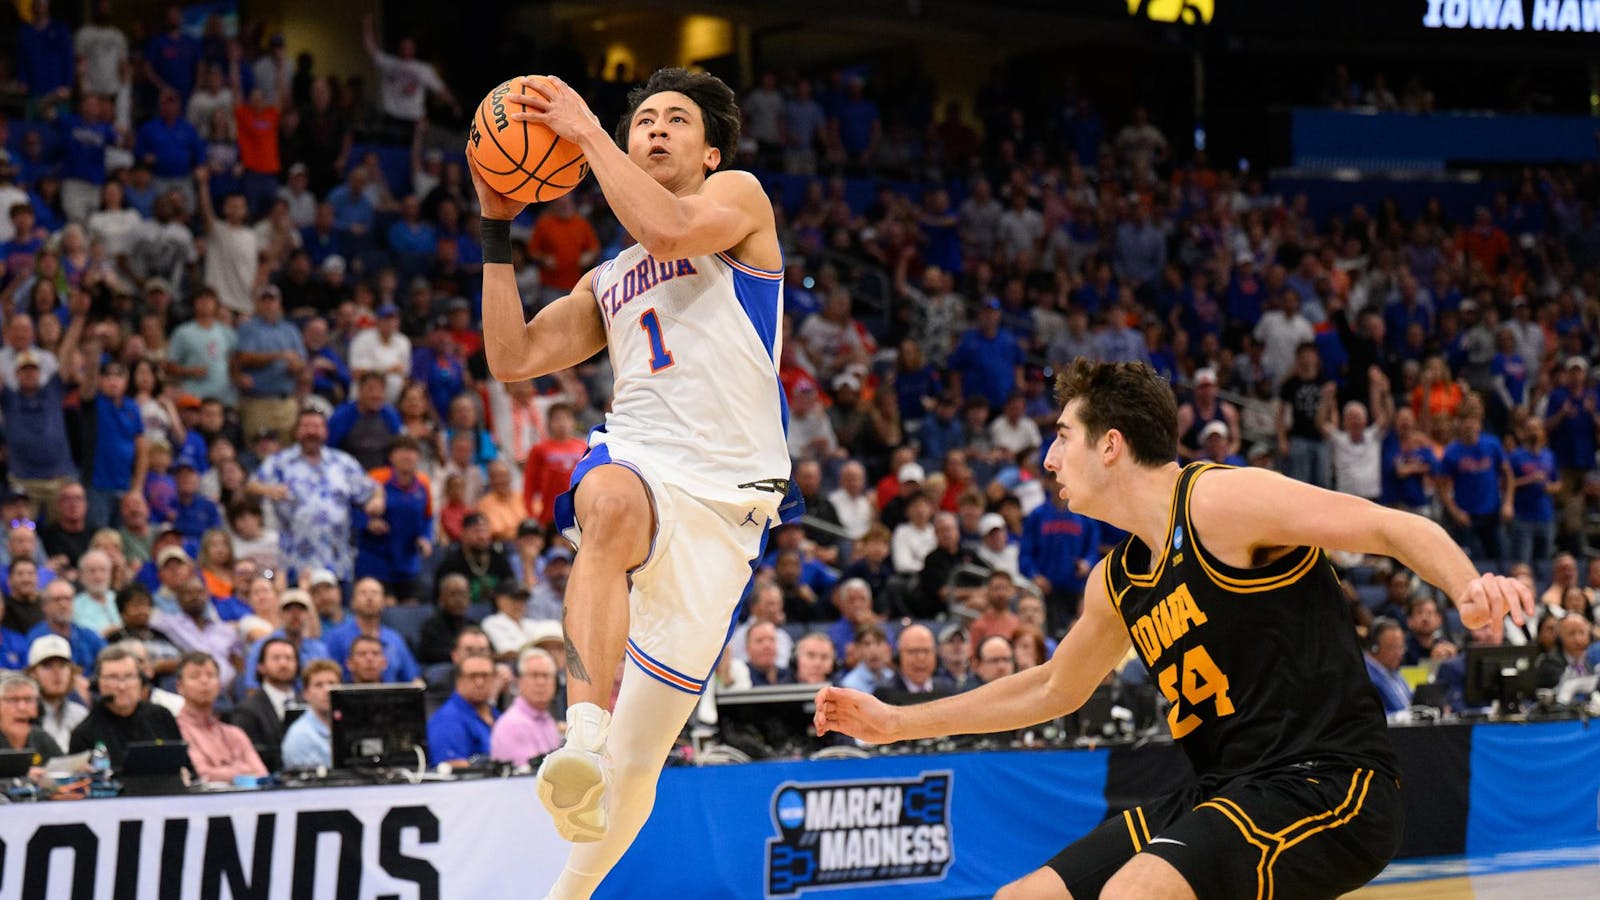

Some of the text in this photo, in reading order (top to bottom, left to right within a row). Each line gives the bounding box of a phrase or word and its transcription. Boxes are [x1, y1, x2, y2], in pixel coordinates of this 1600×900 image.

[1423, 0, 1524, 30] IOWA
[600, 254, 698, 331] FLORIDA
[640, 307, 675, 374] 1
[1130, 582, 1208, 668] IOWA
[1158, 645, 1235, 739] 24
[804, 786, 903, 831] MARCH
[0, 805, 440, 900] OUNDS
[819, 824, 950, 871] MADNESS
